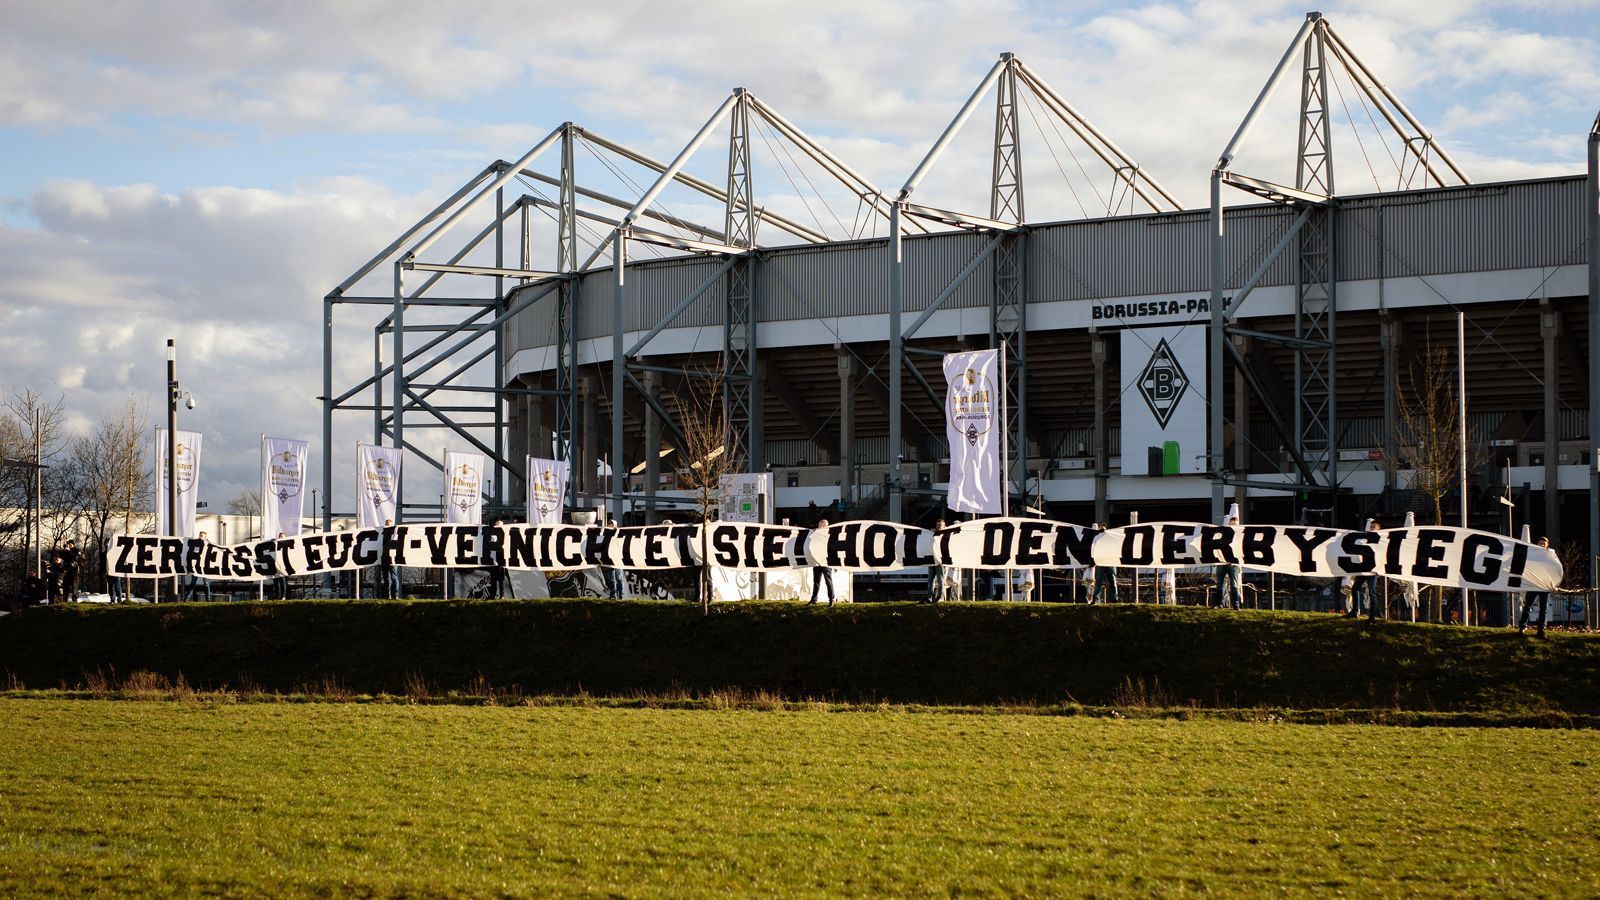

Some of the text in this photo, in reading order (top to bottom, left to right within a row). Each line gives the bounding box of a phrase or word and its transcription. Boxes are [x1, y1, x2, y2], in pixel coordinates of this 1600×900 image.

[115, 536, 295, 577] ZERREISST
[713, 525, 809, 568] SIE!
[826, 523, 961, 567] HOLT
[980, 521, 1105, 566] DEN
